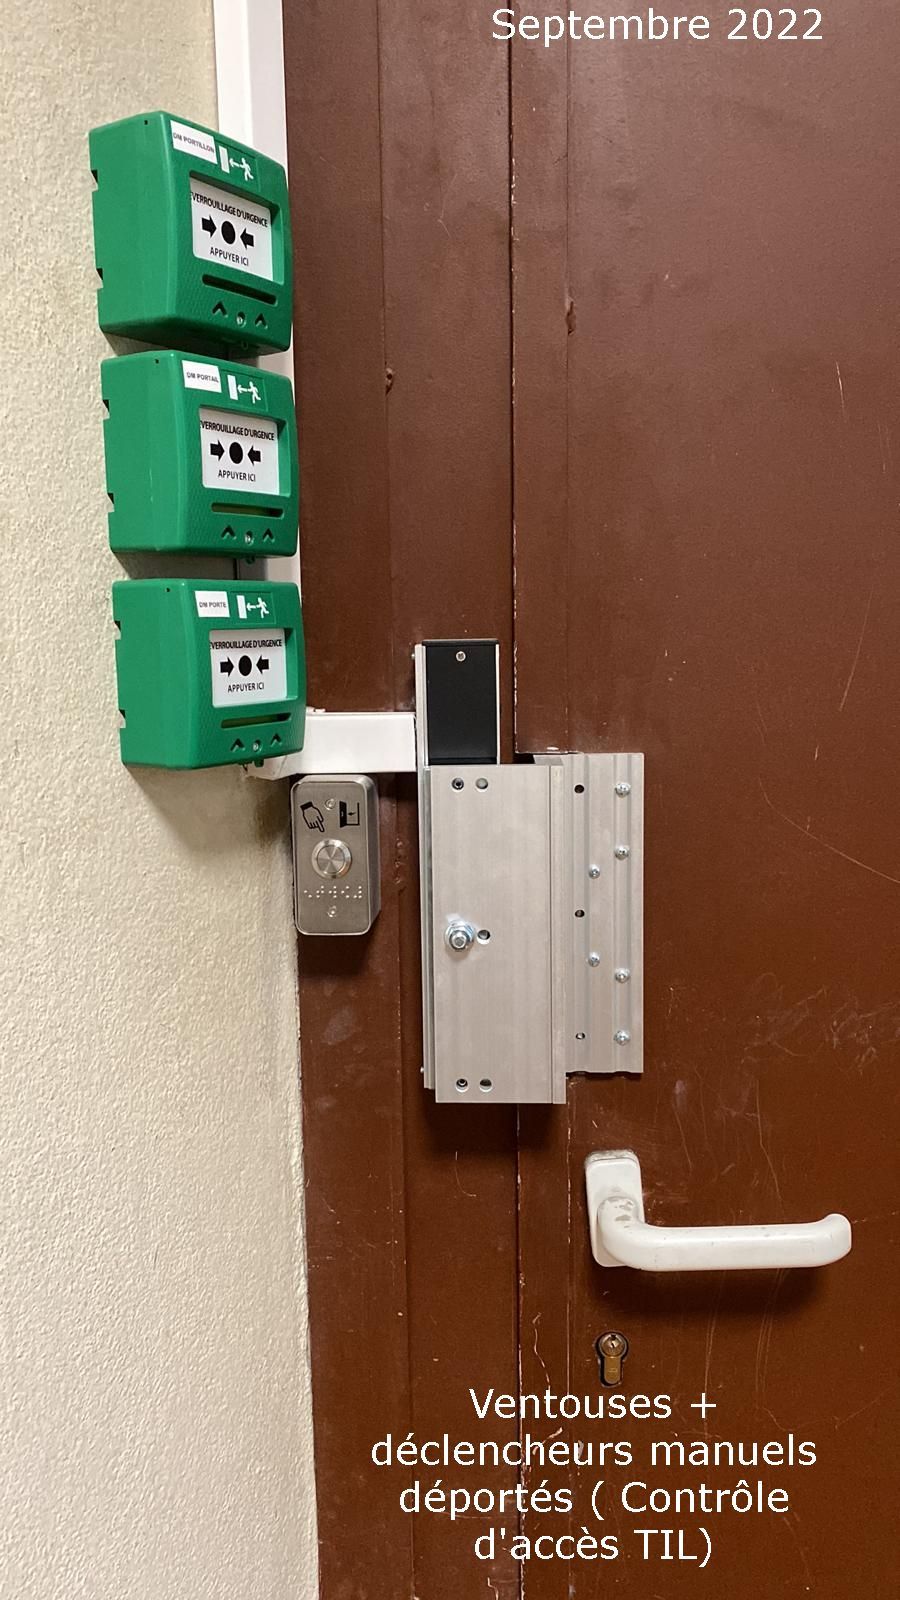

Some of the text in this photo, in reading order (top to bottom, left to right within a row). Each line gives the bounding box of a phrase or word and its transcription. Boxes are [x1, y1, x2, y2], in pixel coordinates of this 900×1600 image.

[183, 135, 215, 154] PORTILLON
[191, 192, 268, 228] VERROUILLAGE D'URGENCE
[210, 247, 249, 266] APPUYER ICI
[197, 373, 219, 383] PORTAIL
[200, 420, 275, 441] VERROUILLAGE D'URGENCE
[218, 469, 256, 482] APPUYER ICI
[210, 639, 282, 650] VERROUILLAGE D'URGENCE
[227, 682, 265, 693] APPUYER ICI
